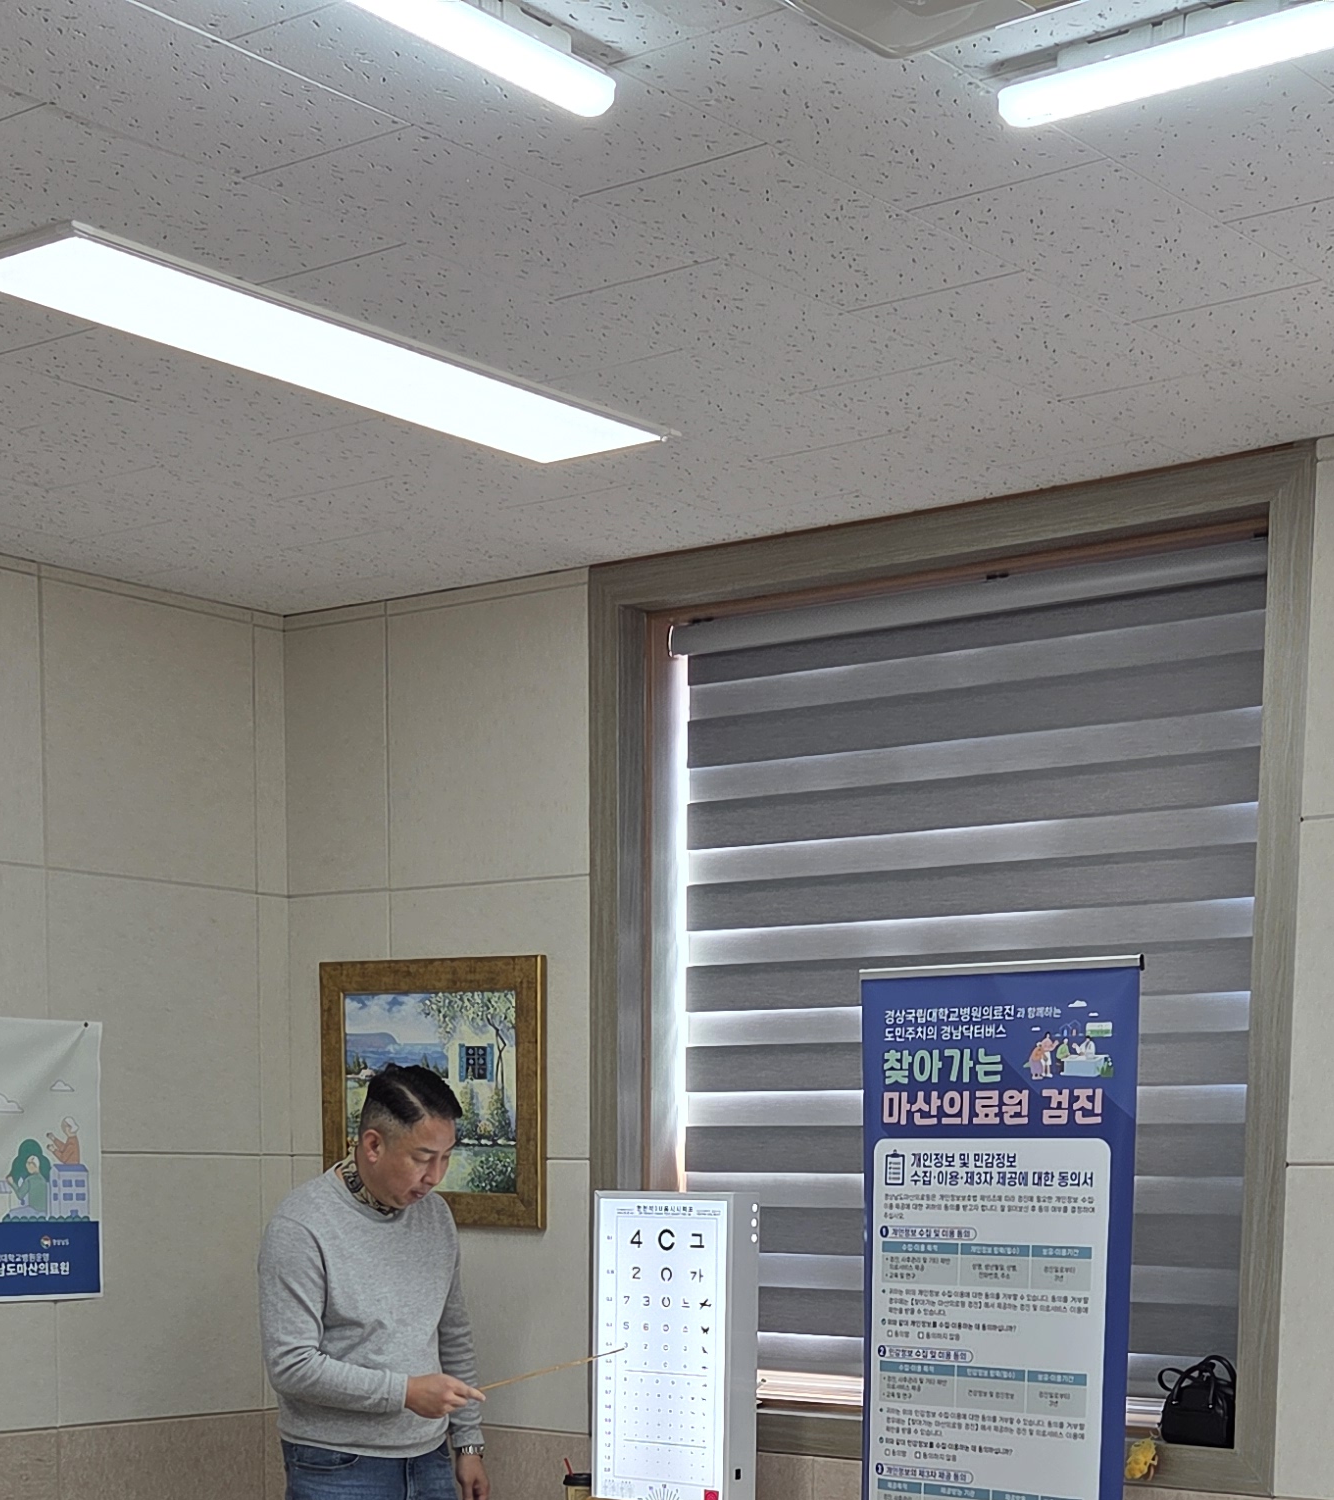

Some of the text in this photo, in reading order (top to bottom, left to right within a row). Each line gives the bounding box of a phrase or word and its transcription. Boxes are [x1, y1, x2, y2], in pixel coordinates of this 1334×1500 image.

[884, 1024, 1007, 1042] 도민주치의 경남닥터버스
[883, 1048, 1003, 1084] 찾아가는
[882, 1088, 1103, 1126] 마산의료원 검진
[911, 1152, 1017, 1168] 개인정보 및 민감정보
[910, 1170, 1093, 1188] 수집·이용·제3자 제공에 대한 동의서
[630, 1229, 643, 1248] 4
[632, 1266, 704, 1283] 2 가
[623, 1296, 630, 1304] 7
[643, 1296, 650, 1306] 3
[623, 1322, 629, 1330] 5
[643, 1322, 649, 1332] 6
